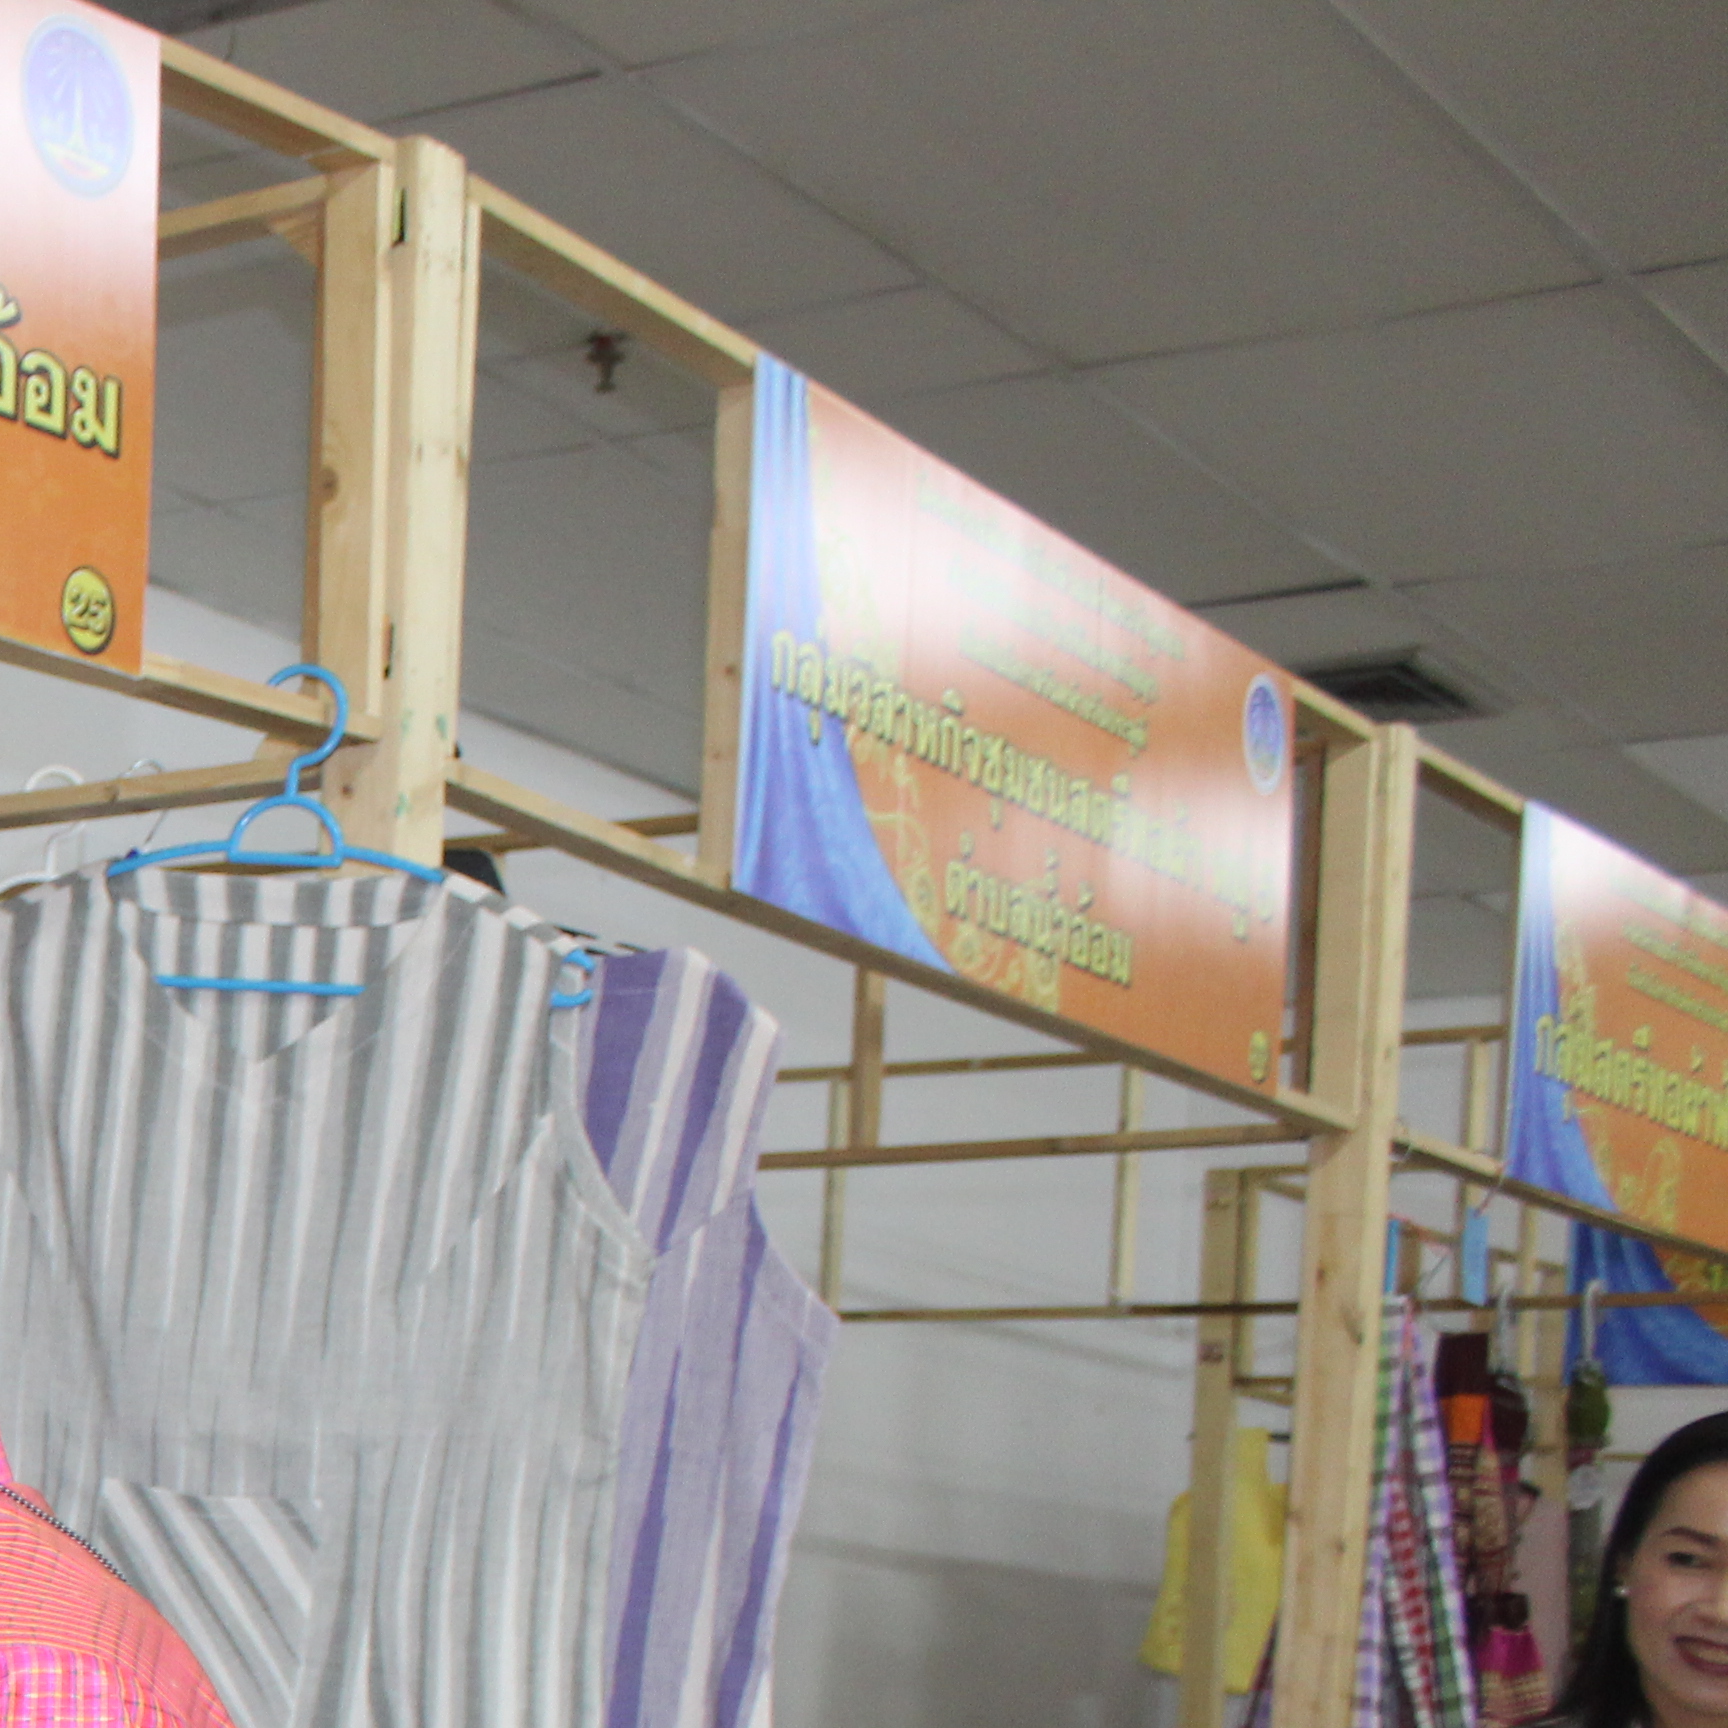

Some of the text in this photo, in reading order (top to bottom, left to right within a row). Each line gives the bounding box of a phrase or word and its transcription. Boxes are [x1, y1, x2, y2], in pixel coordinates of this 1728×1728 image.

[945, 830, 1134, 988] ตำบลน้ำอ้อม
